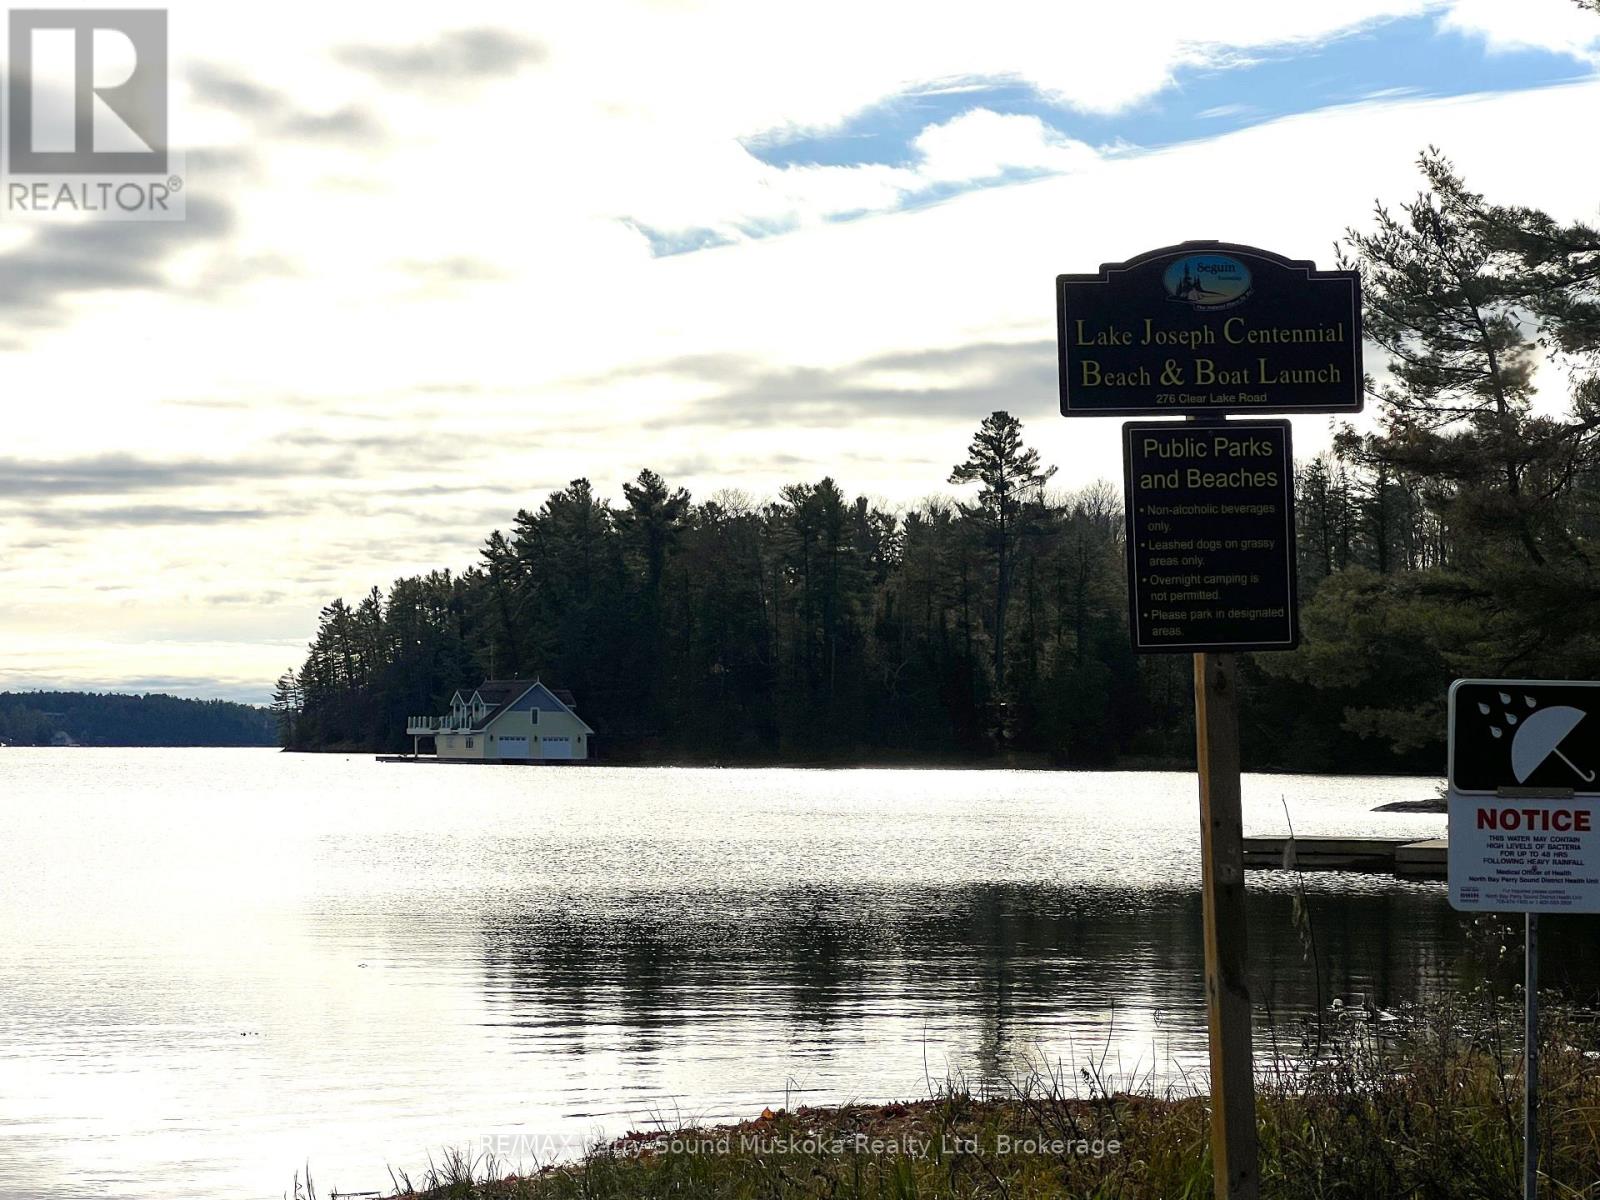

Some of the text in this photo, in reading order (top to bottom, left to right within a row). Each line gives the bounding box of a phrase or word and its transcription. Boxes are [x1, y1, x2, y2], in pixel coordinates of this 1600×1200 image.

[1196, 262, 1236, 275] Seguin
[1075, 317, 1344, 349] Lake Joseph Centennial
[1081, 357, 1341, 387] Beach & Boat Launch
[1156, 392, 1267, 404] 276 Clear Lake Road
[1143, 436, 1273, 458] Public Parks
[1140, 468, 1278, 489] and Beaches
[1147, 503, 1276, 517] Non-alcoholic beverages
[1149, 538, 1275, 552] Leashed dogs on grassy
[1149, 556, 1179, 567] areas
[1150, 573, 1260, 587] Overnight camping is
[1150, 591, 1168, 602] not
[1151, 607, 1284, 621] Please park in designated
[1477, 808, 1591, 831] NOTICE
[1483, 857, 1524, 865] FOLLOWING
